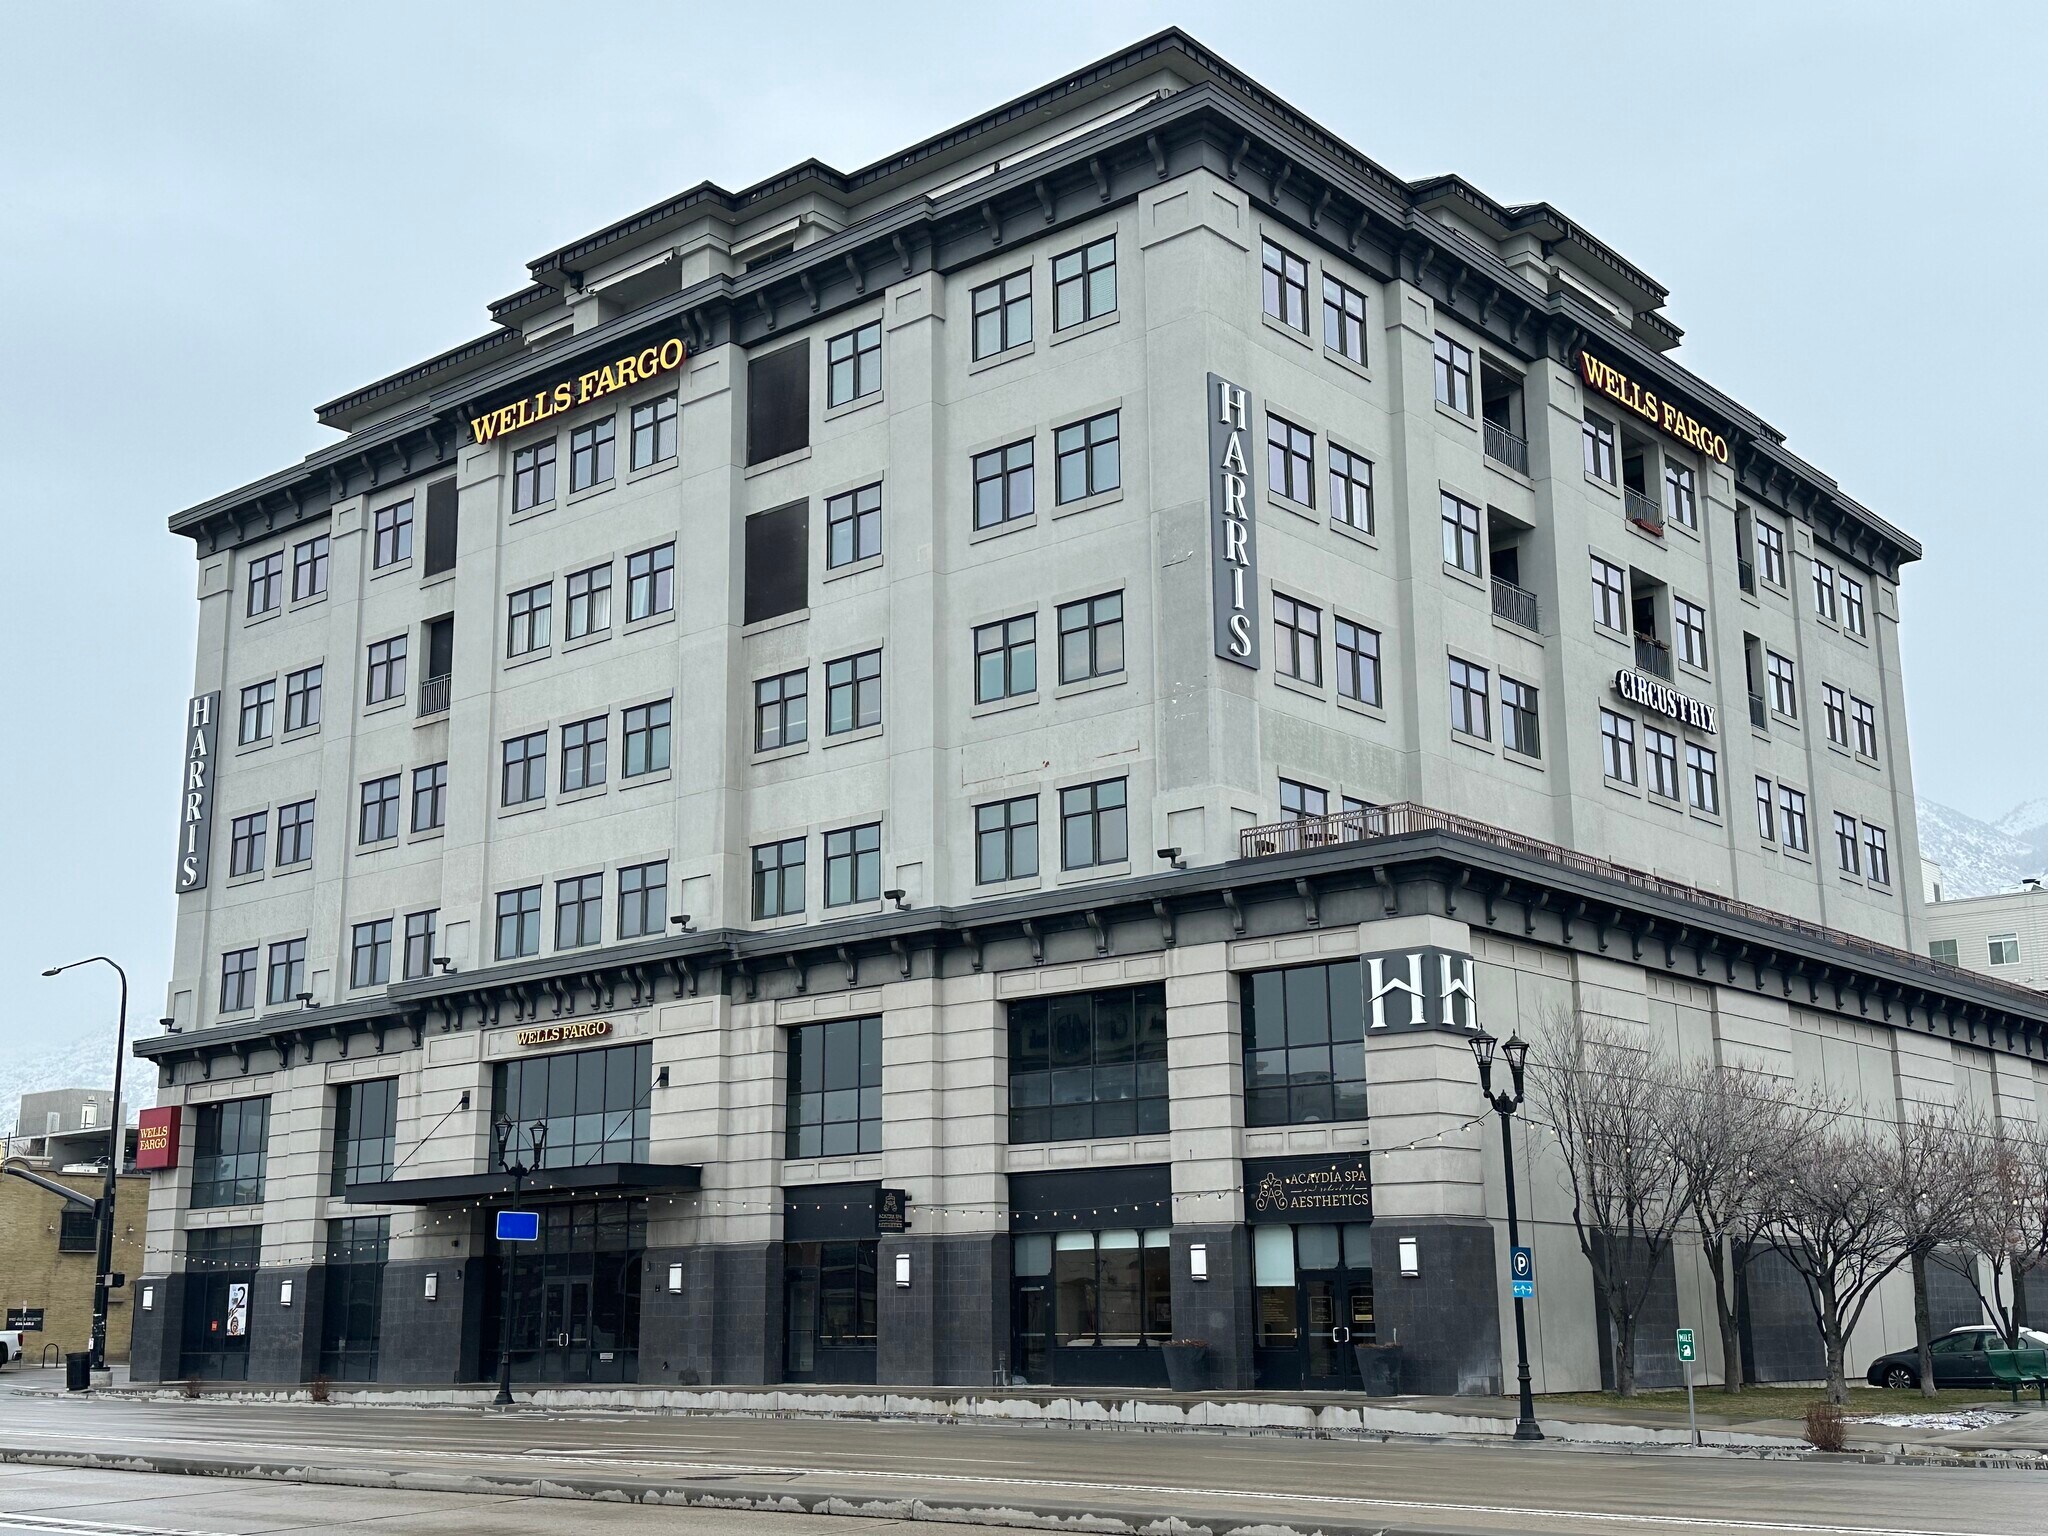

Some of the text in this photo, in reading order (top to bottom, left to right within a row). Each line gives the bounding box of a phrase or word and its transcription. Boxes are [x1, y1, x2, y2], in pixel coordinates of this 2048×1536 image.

[471, 338, 684, 444] WELLS FARGO
[1581, 351, 1728, 464] WELLS FARGO
[1217, 381, 1252, 657] HARRIS
[1619, 670, 1717, 734] CIRCUSTRIX
[181, 695, 211, 886] HARRIS
[516, 1021, 606, 1045] WELLS FARGO
[140, 1125, 168, 1139] WELLS
[140, 1137, 167, 1151] FARGO
[1290, 1170, 1367, 1185] ACAYDIA SPA
[1290, 1193, 1369, 1208] AESTHETICS
[1517, 1256, 1526, 1271] P
